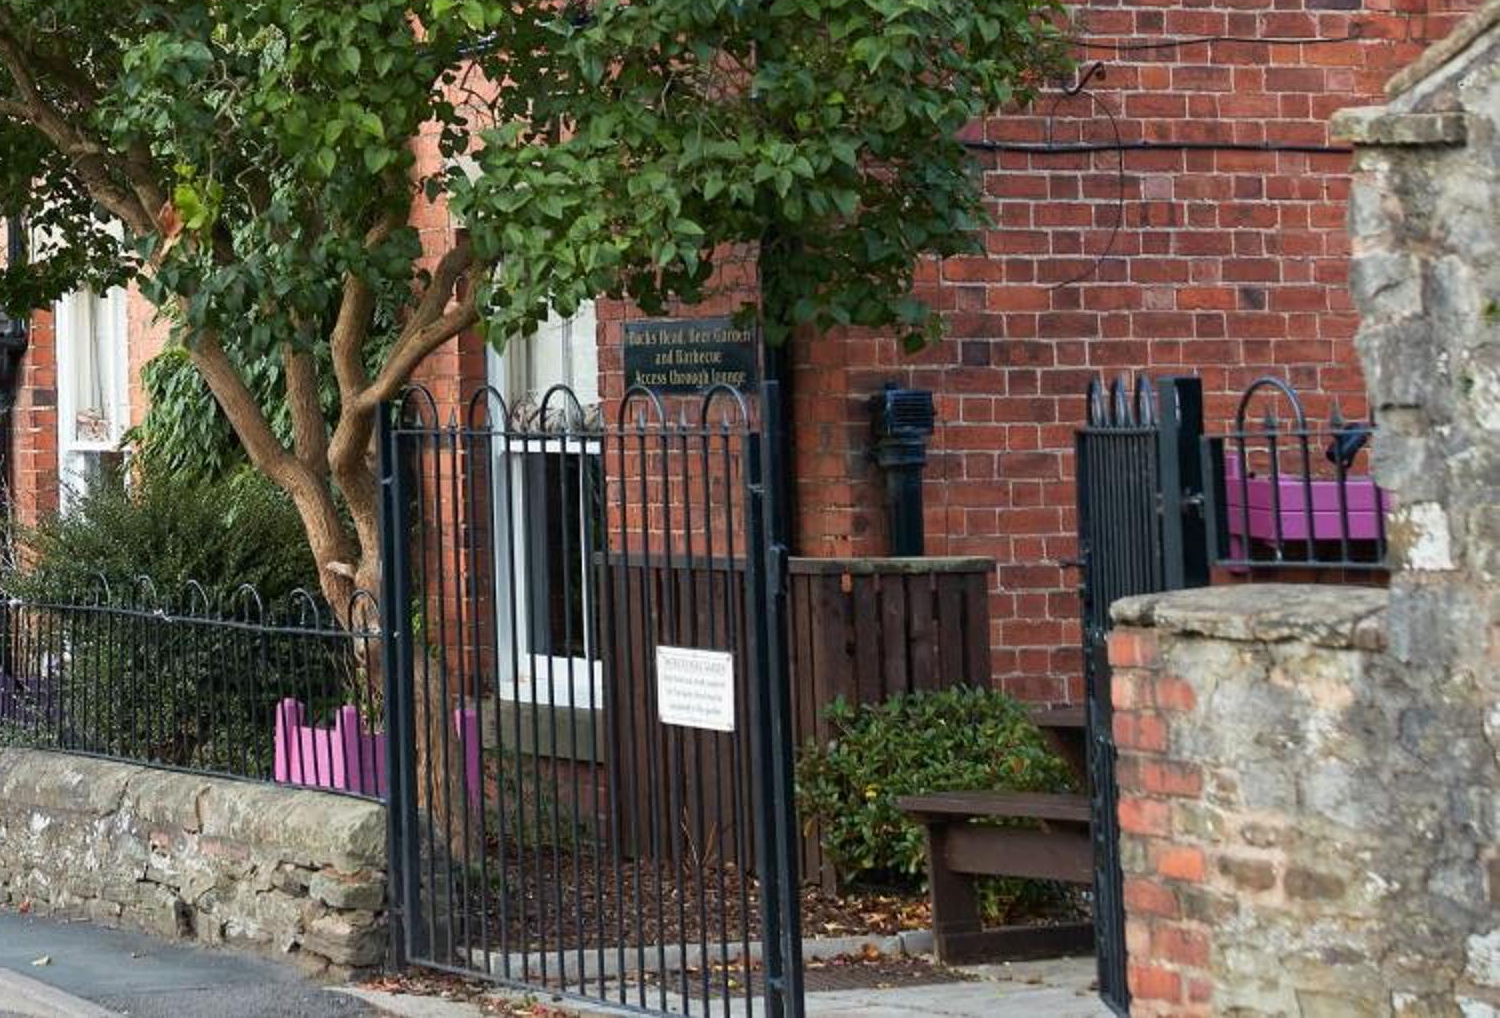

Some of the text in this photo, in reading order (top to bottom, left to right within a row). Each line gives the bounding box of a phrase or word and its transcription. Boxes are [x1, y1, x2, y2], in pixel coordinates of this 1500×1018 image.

[713, 326, 751, 343] Garden
[655, 349, 723, 365] and Barbecue
[635, 370, 667, 385] Access
[669, 369, 709, 388] through
